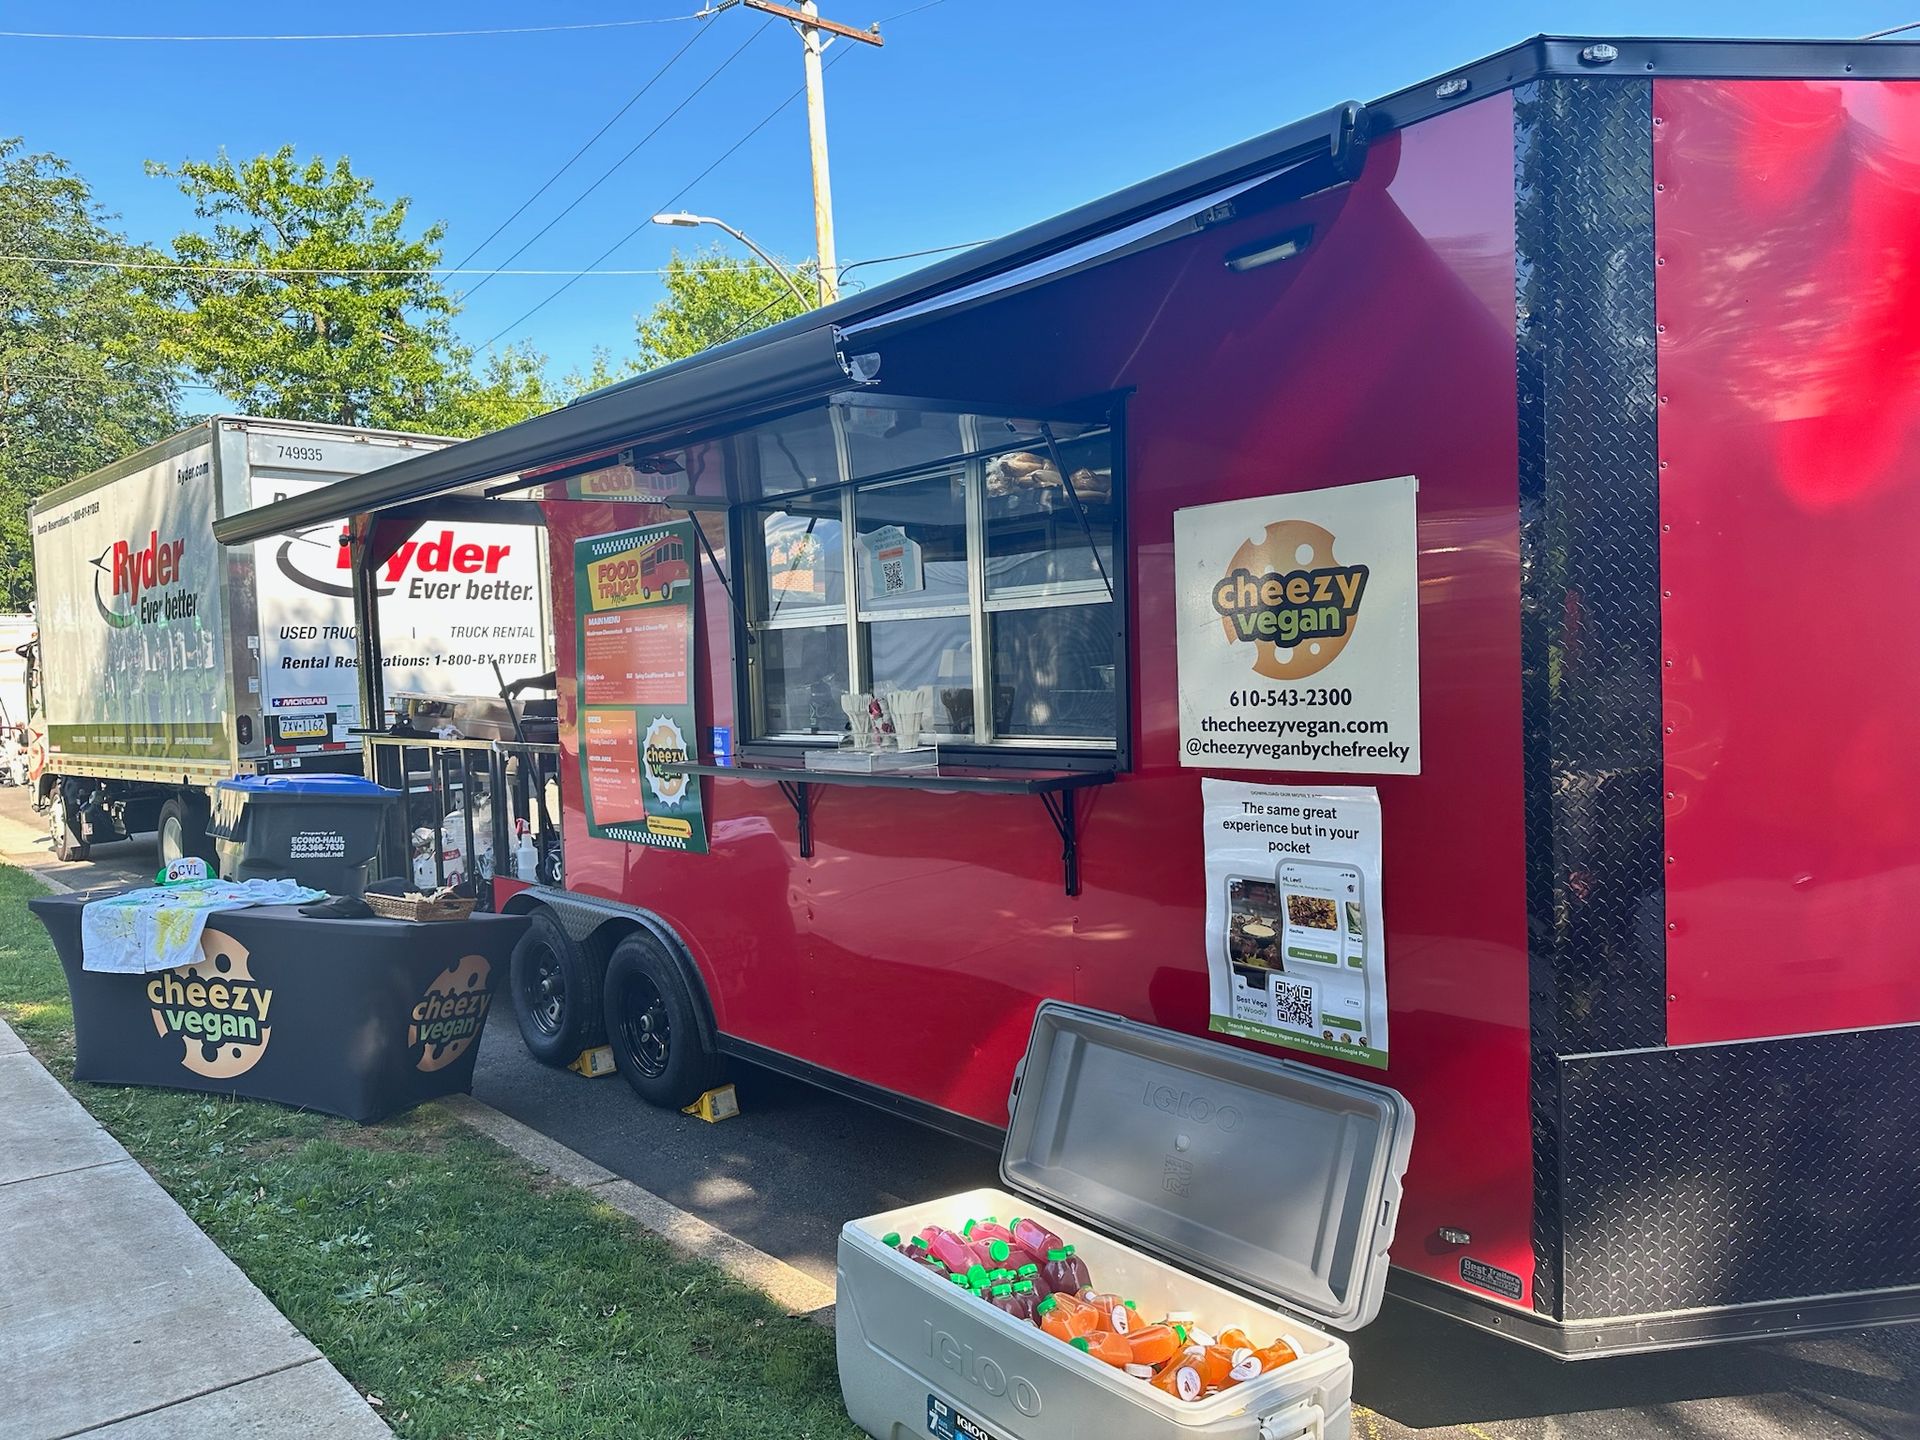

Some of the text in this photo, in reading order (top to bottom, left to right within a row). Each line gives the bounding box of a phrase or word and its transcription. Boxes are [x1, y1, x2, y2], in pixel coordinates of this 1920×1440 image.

[277, 446, 323, 461] 749935
[177, 462, 209, 485] Ryder.com
[113, 530, 185, 606] Ryder
[598, 559, 639, 584] FOOD
[408, 578, 534, 600] Ever better.
[598, 579, 639, 600] TRUCK
[1217, 572, 1362, 609] cheezy
[141, 598, 163, 625] Ever
[588, 615, 621, 626] MAIN MENU
[1238, 605, 1341, 640] vegan
[280, 626, 317, 640] USED
[450, 626, 536, 638] TRUCK RENTAL
[282, 655, 329, 669] Rental
[282, 697, 326, 707] MORGAN
[1230, 688, 1352, 707] 610-543-2300
[1201, 716, 1389, 738] thecheezyvegan.com
[1186, 737, 1410, 763] @cheezyveganbychefreeky
[1242, 801, 1337, 820] The same great
[291, 836, 345, 844] ECONO-HAUL
[1222, 820, 1360, 840] experience but in your
[1268, 840, 1311, 854] pocket
[178, 864, 200, 876] CVL
[147, 974, 273, 1021] cheezy
[412, 990, 492, 1022] cheezy
[1236, 995, 1251, 1004] Best
[166, 1008, 257, 1042] vegan
[420, 1019, 476, 1044] vegan
[1227, 1022, 1244, 1030] Search
[1251, 1026, 1261, 1034] The
[1261, 1028, 1278, 1038] Cheezy
[1278, 1032, 1293, 1042] Vegan
[1301, 1037, 1309, 1045] the
[1309, 1040, 1321, 1048] App
[1321, 1042, 1334, 1051] Store
[1339, 1047, 1358, 1056] Google
[1358, 1049, 1371, 1059] Play
[1143, 1080, 1246, 1133] IGLOO
[1464, 1259, 1488, 1276] Best
[923, 1319, 1042, 1418] IGLOO
[929, 1409, 939, 1430] 7
[956, 1414, 988, 1440] IGLOO
